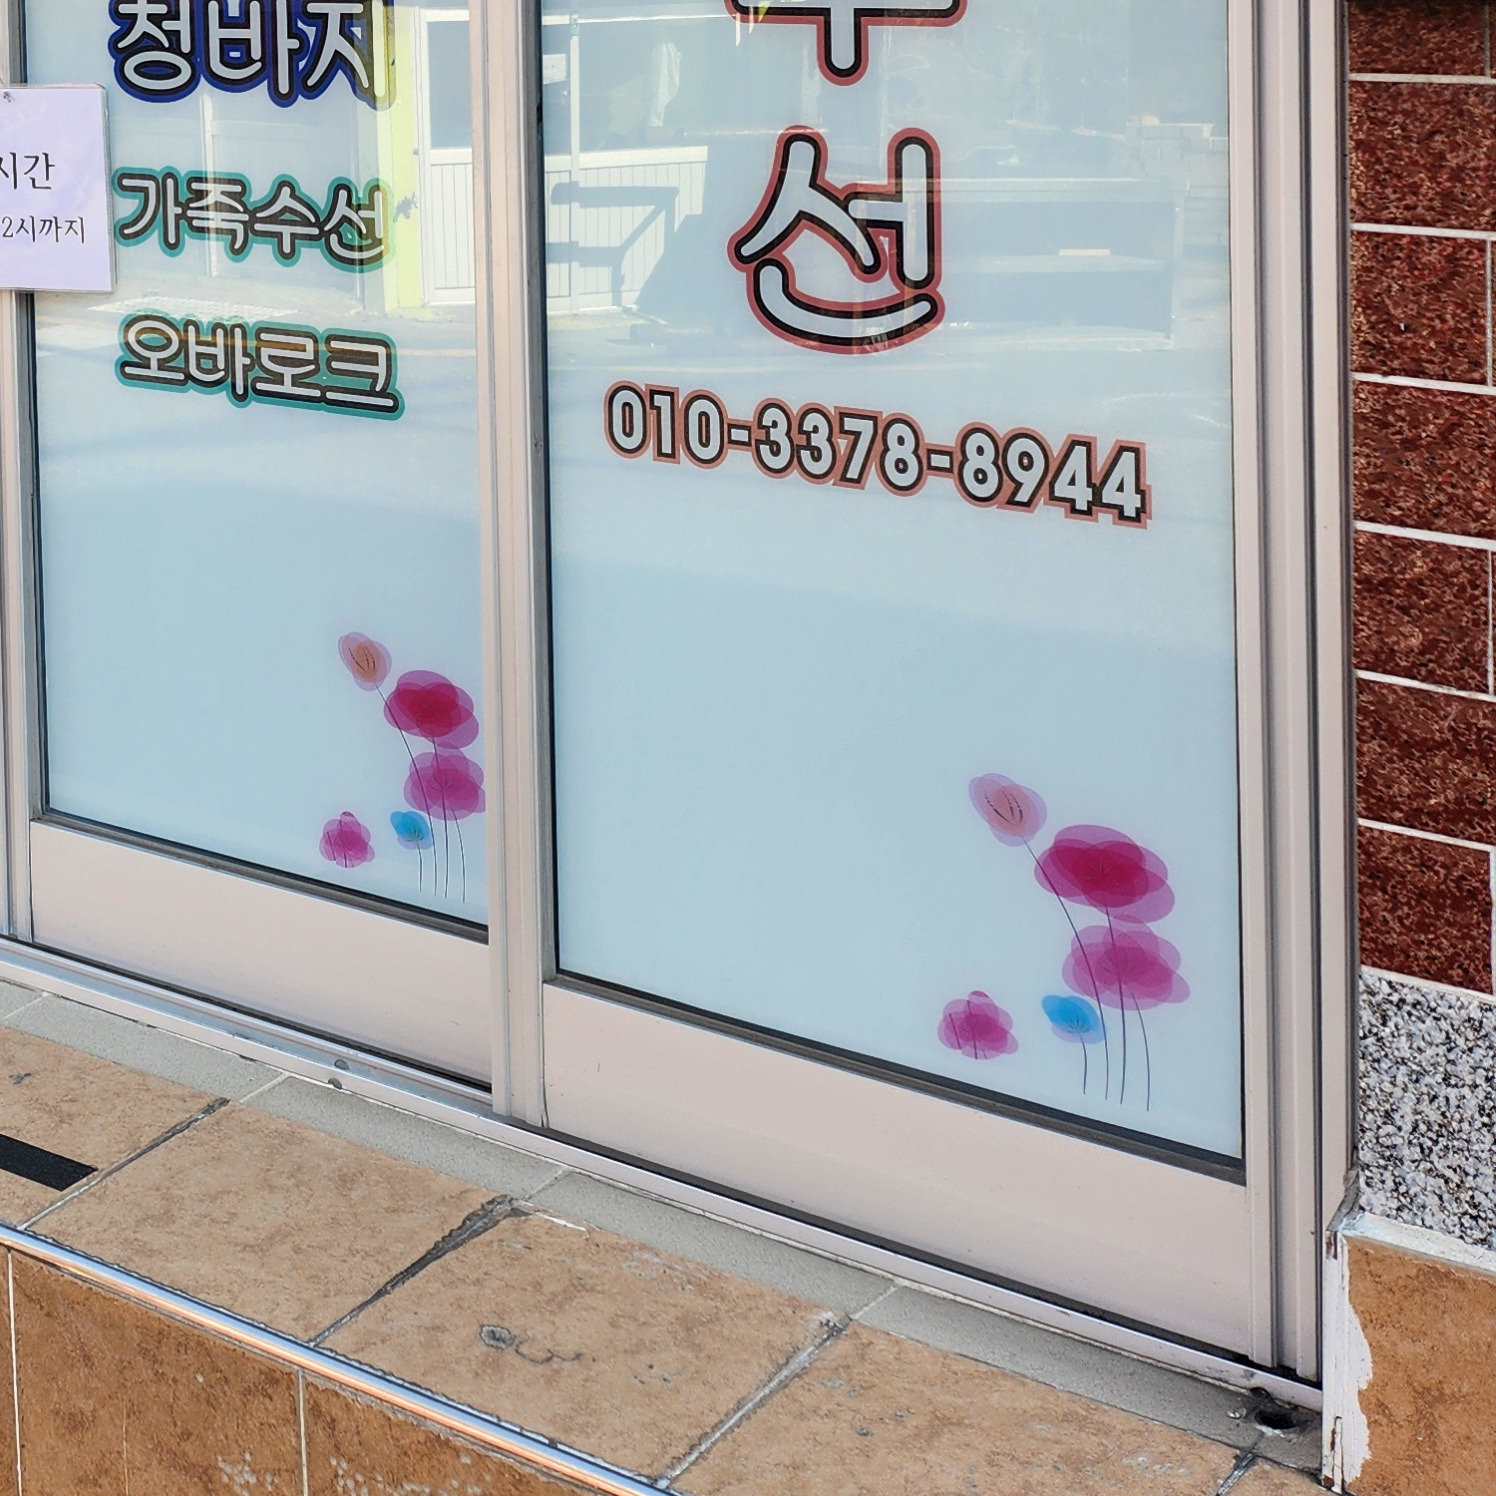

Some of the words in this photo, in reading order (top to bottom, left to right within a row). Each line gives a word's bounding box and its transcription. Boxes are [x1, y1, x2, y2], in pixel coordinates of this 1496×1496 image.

[1, 214, 86, 245] 2시까지
[113, 166, 394, 273] 가족수선
[116, 312, 405, 421] 오바로크
[603, 379, 1154, 529] 010-3378-8944
